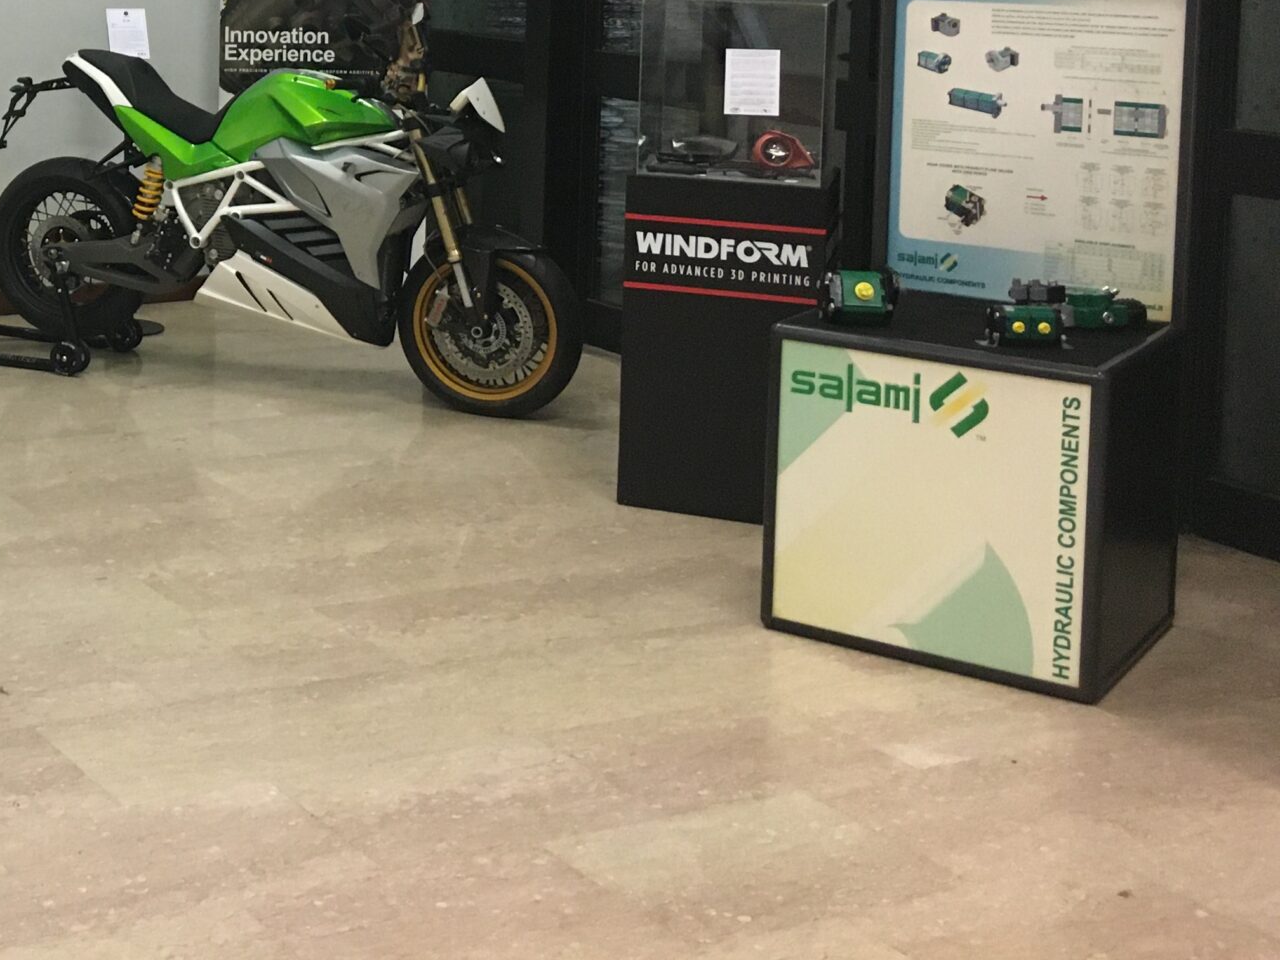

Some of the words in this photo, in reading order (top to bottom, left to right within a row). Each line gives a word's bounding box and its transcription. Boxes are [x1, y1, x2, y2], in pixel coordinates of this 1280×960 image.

[224, 26, 329, 44] Innovation
[224, 44, 336, 65] Experience
[635, 231, 809, 268] WINDFORM
[897, 250, 938, 269] salami
[635, 261, 656, 273] FOR
[663, 263, 724, 279] ADVANCED
[730, 269, 745, 281] 3D
[751, 271, 810, 288] PRINTING
[790, 363, 921, 423] salami
[1057, 396, 1081, 549] COMPONENTS
[1052, 554, 1075, 680] HYDRAULIC
